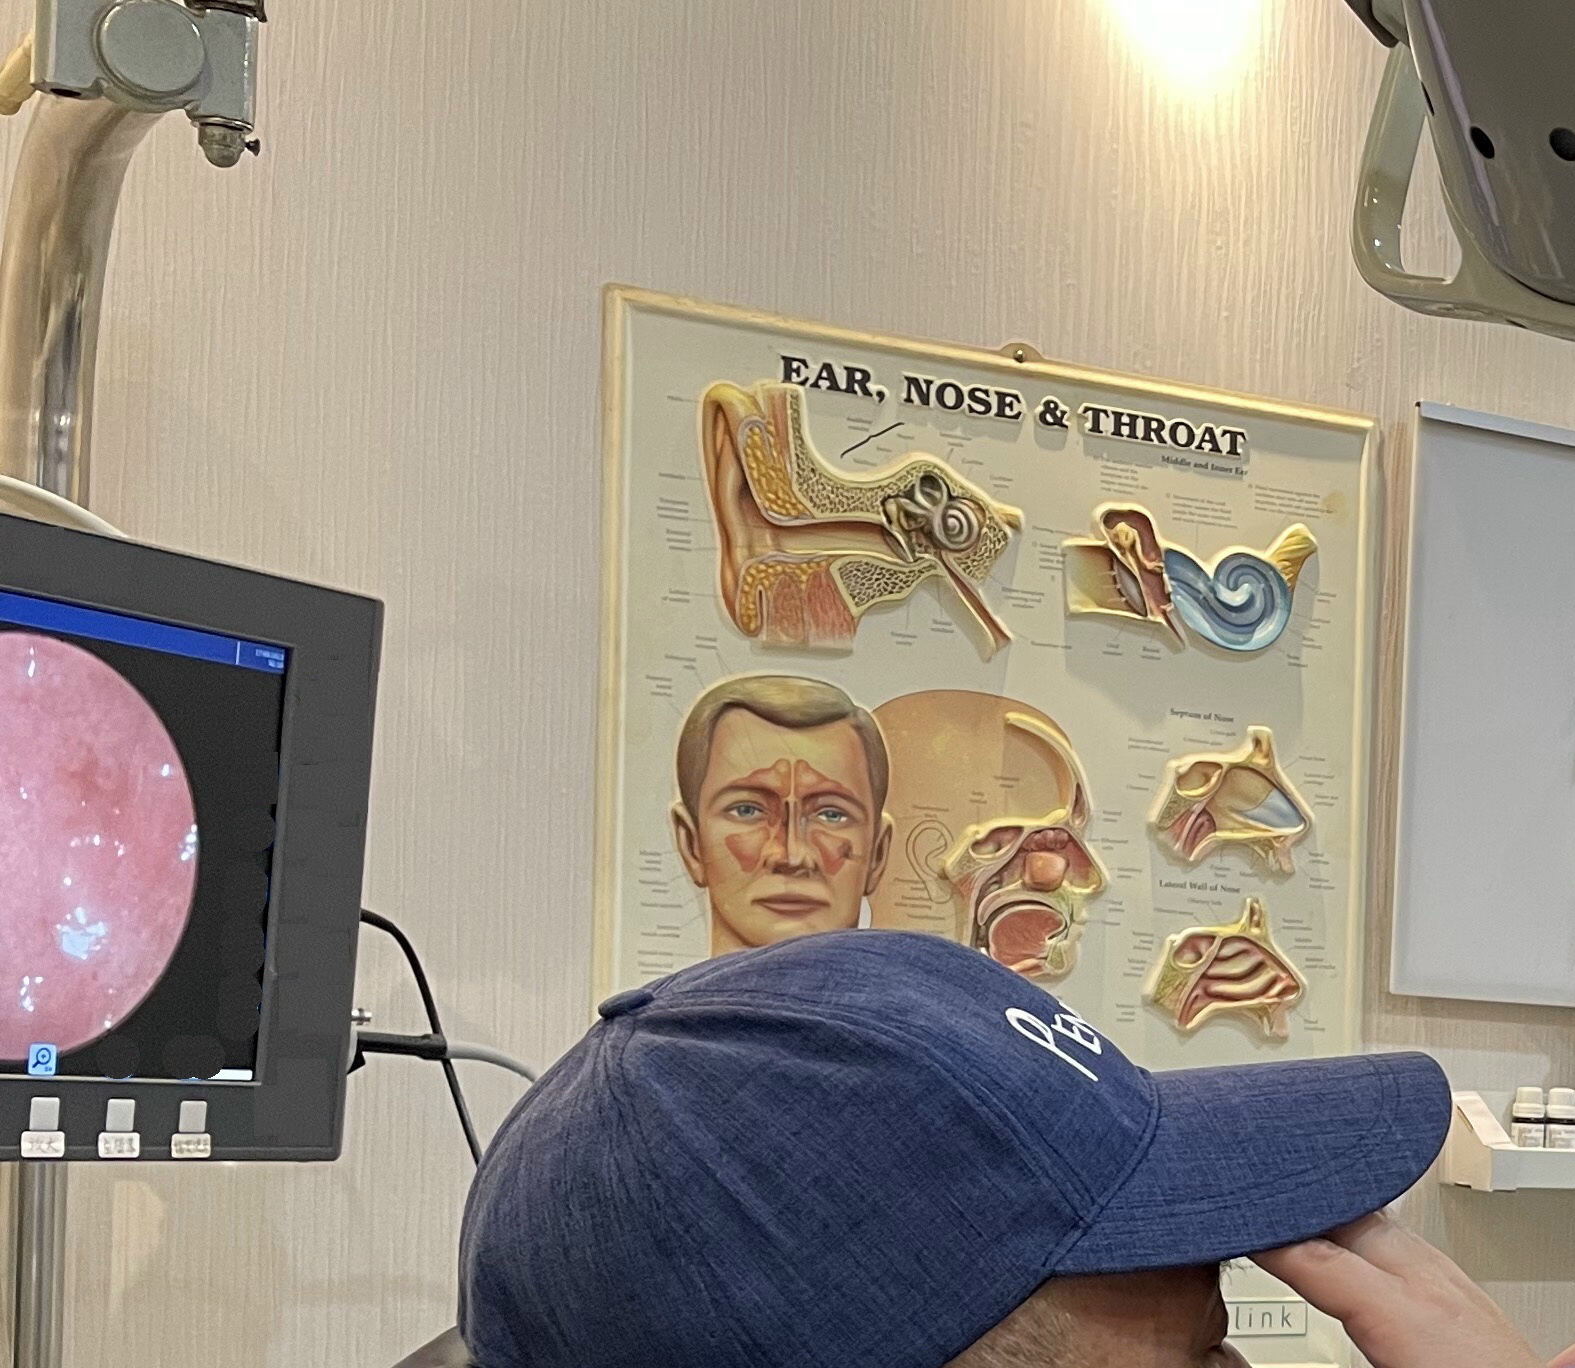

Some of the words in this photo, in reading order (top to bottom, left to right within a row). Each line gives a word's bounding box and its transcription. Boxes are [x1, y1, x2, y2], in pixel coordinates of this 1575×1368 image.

[781, 355, 886, 403] EAR,
[903, 375, 1022, 420] NOSE
[1039, 400, 1068, 429] &
[1082, 406, 1247, 456] THROAT
[1161, 455, 1191, 467] Middle
[1193, 462, 1209, 470] and
[1209, 884, 1218, 892] of
[1005, 1002, 1102, 1082] PE
